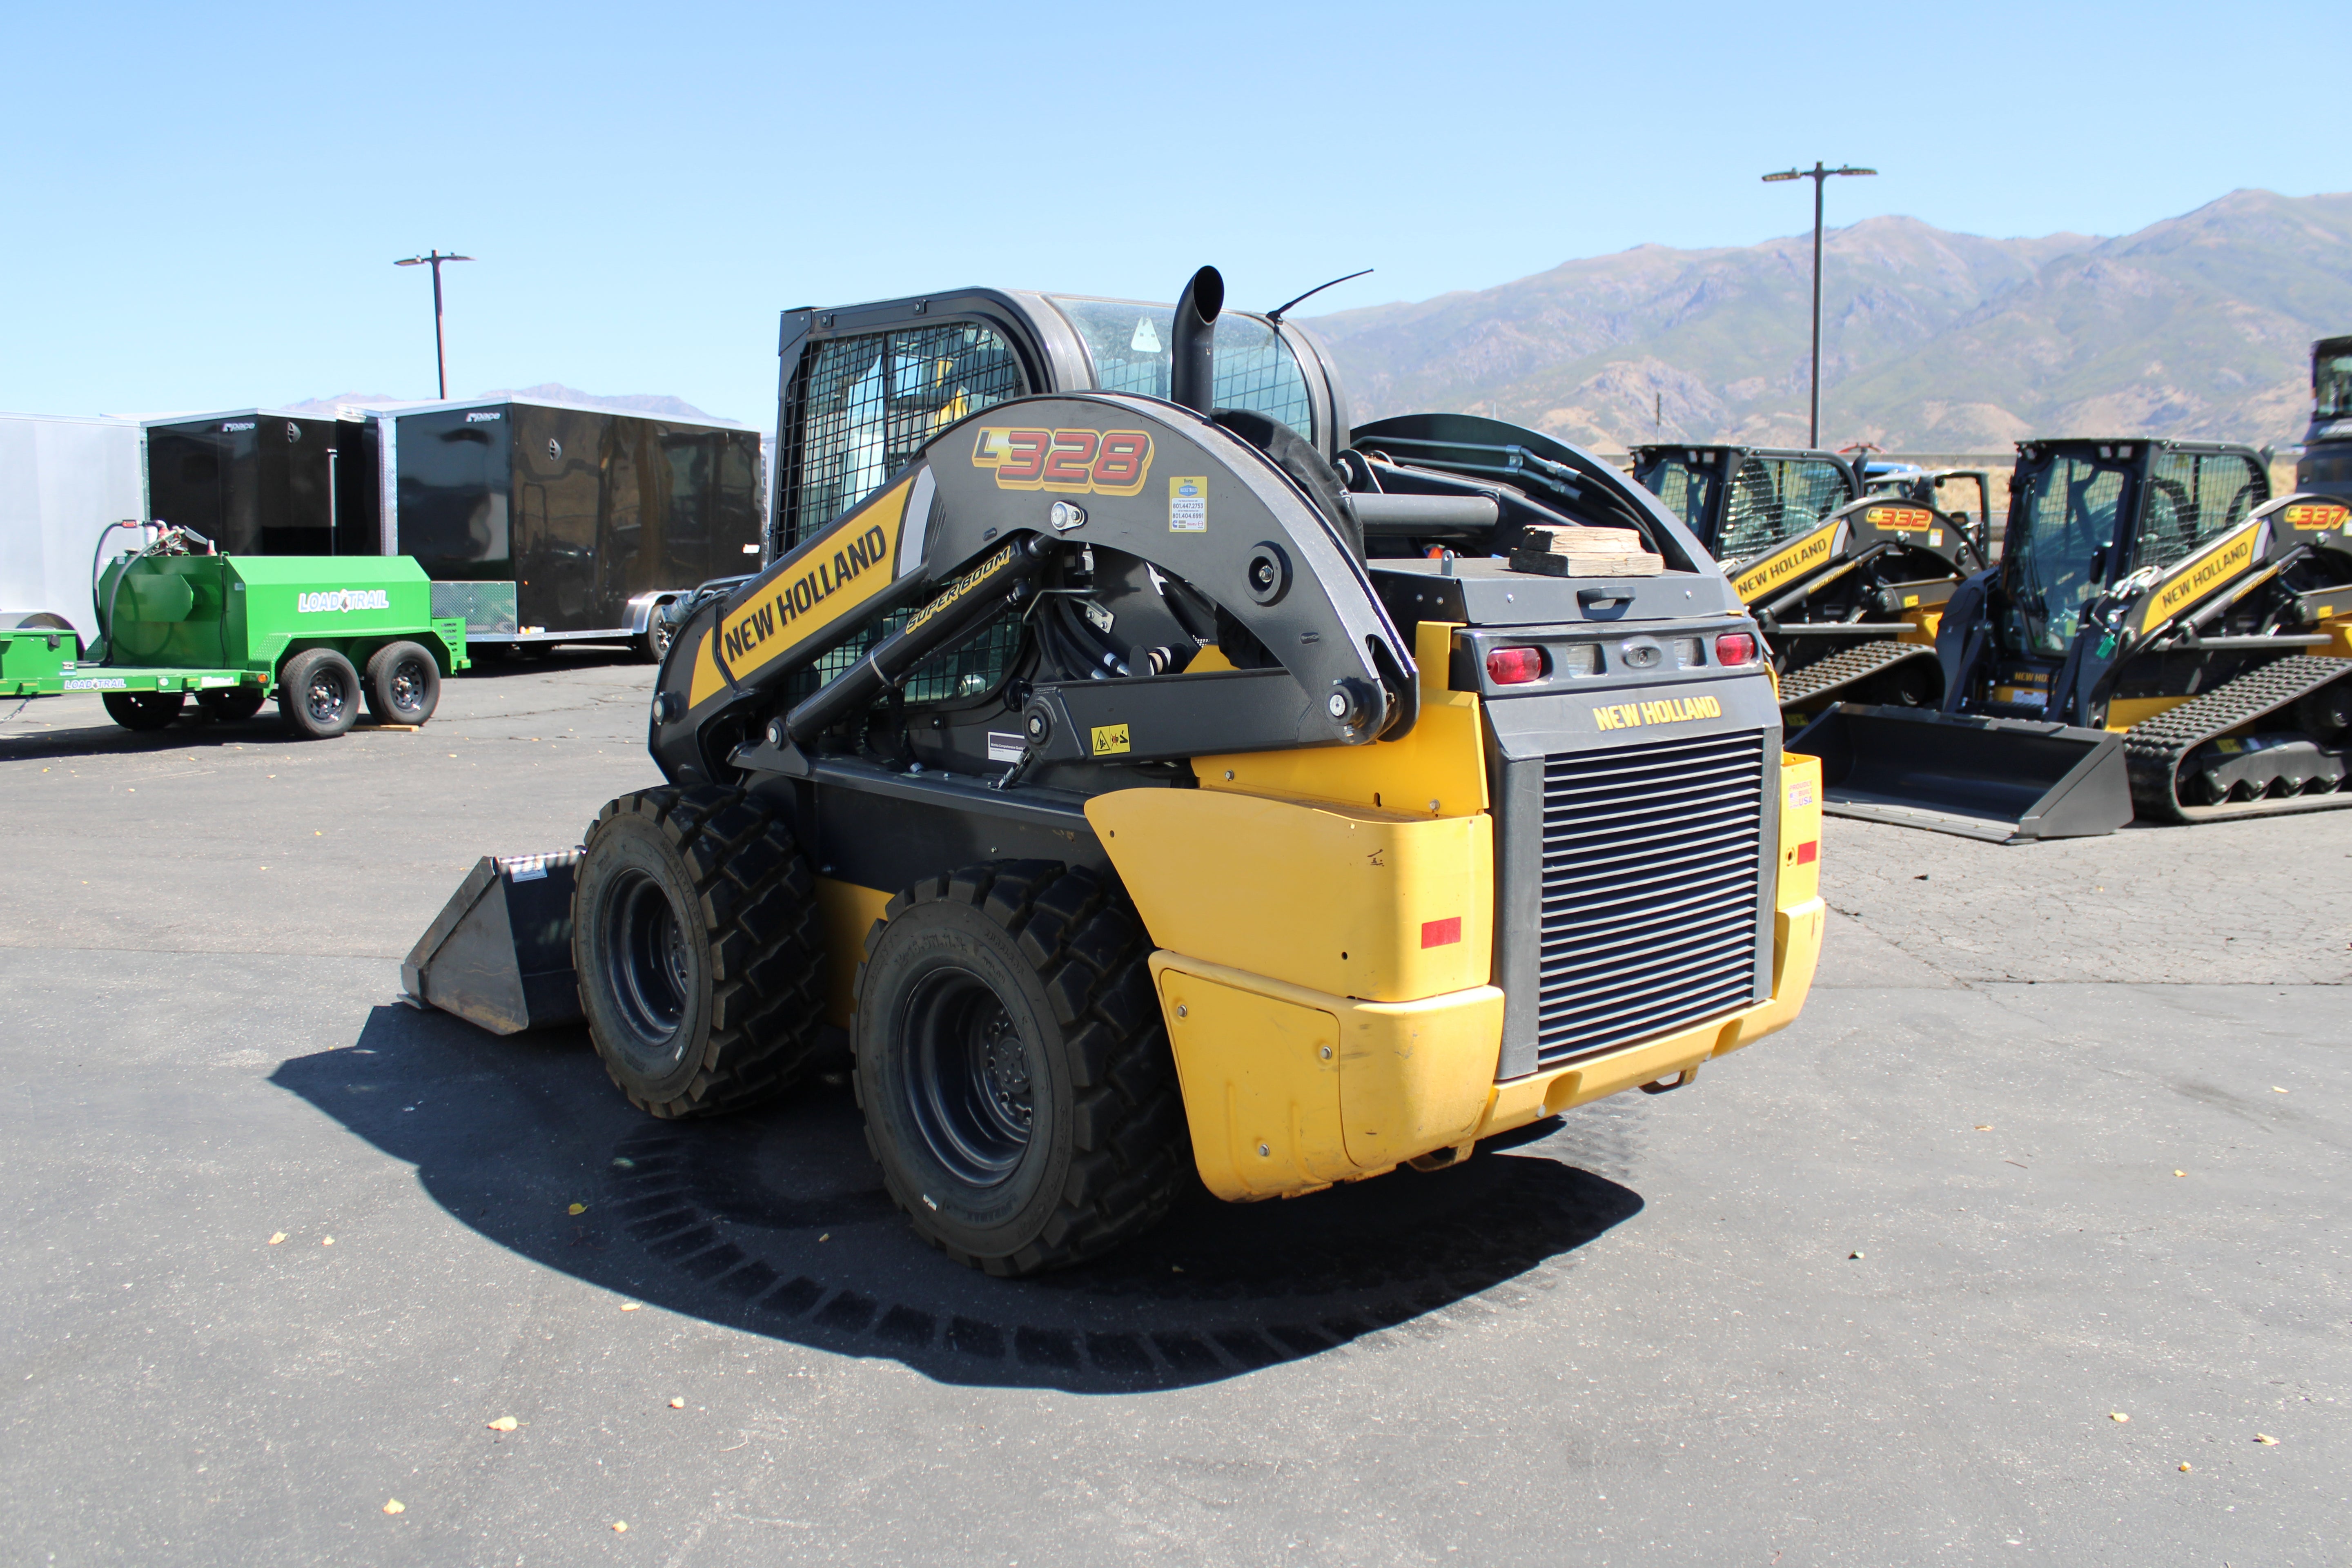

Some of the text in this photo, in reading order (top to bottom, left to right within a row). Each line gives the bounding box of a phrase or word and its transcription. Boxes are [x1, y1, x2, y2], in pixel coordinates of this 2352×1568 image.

[972, 427, 1154, 496] L328
[1738, 537, 1827, 596] NEW HOLLAND
[2163, 541, 2248, 608] NEW HOLLAND
[299, 591, 388, 611] LOAD TRAIL
[724, 525, 887, 662] NEW HOLLAND
[905, 545, 1010, 635] SUPER BOOM
[65, 679, 126, 689] LOAD TRAIL
[2014, 672, 2034, 682] NEW
[1593, 695, 1722, 731] NEW HOLLAND
[1789, 780, 1813, 791] PROUDLY
[1799, 787, 1813, 796] BUILT
[1799, 795, 1813, 806] USA
